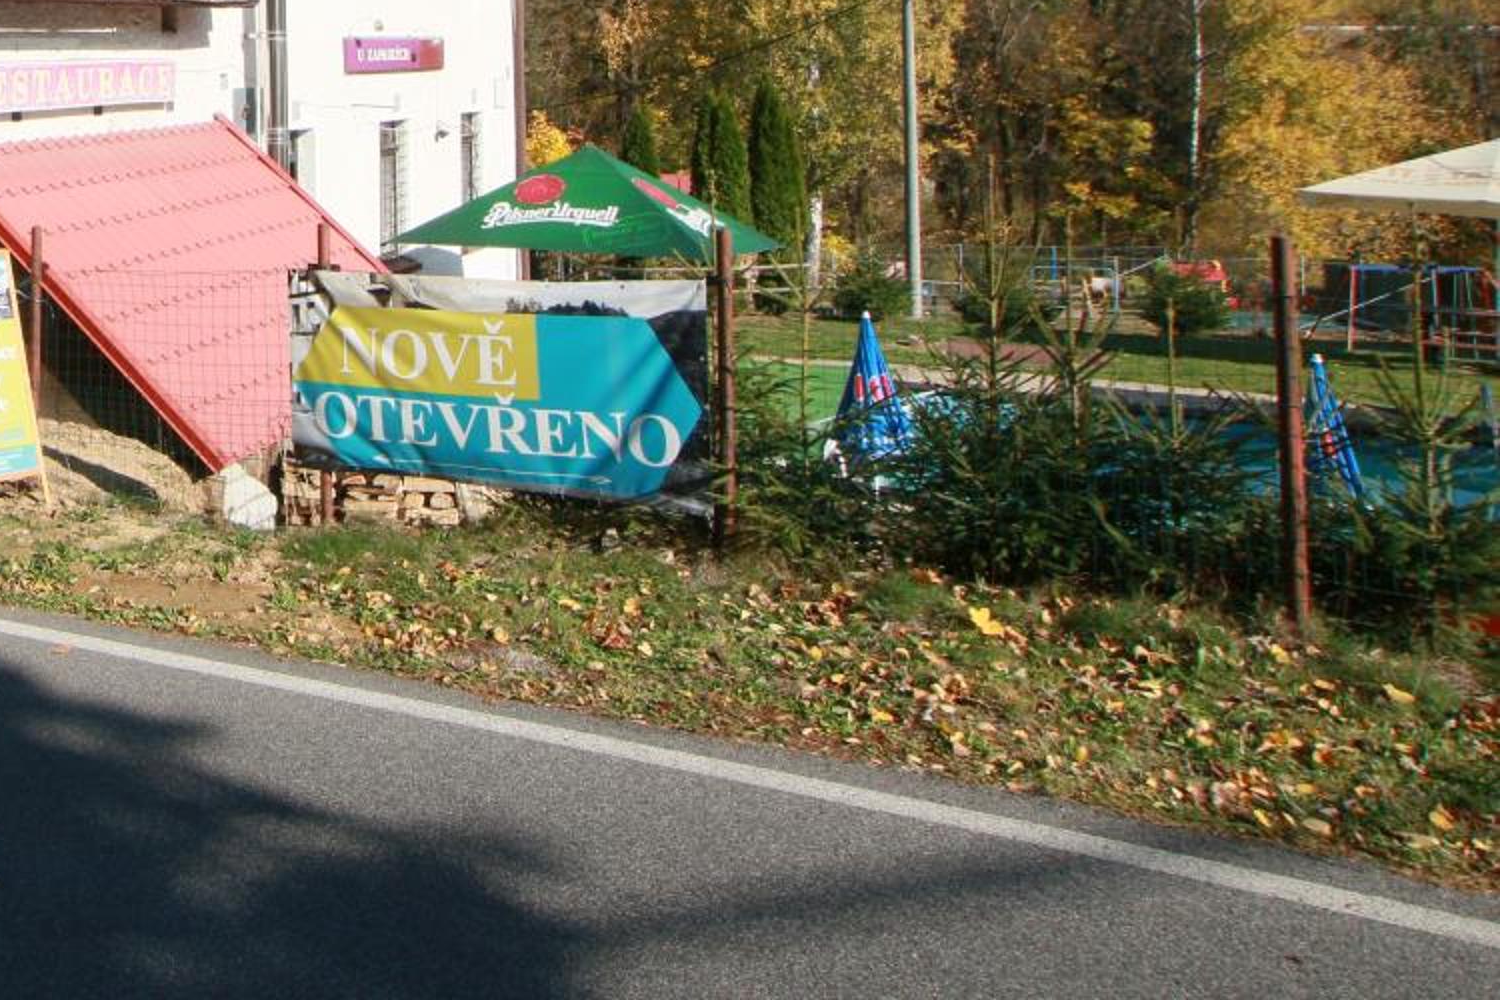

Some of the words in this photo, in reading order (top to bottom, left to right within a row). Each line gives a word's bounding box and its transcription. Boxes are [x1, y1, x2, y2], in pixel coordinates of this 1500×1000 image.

[480, 201, 553, 229] Pilsner
[552, 200, 620, 227] Urquell
[340, 318, 517, 387] NOVĚ
[316, 390, 682, 469] OTEVŘENO
